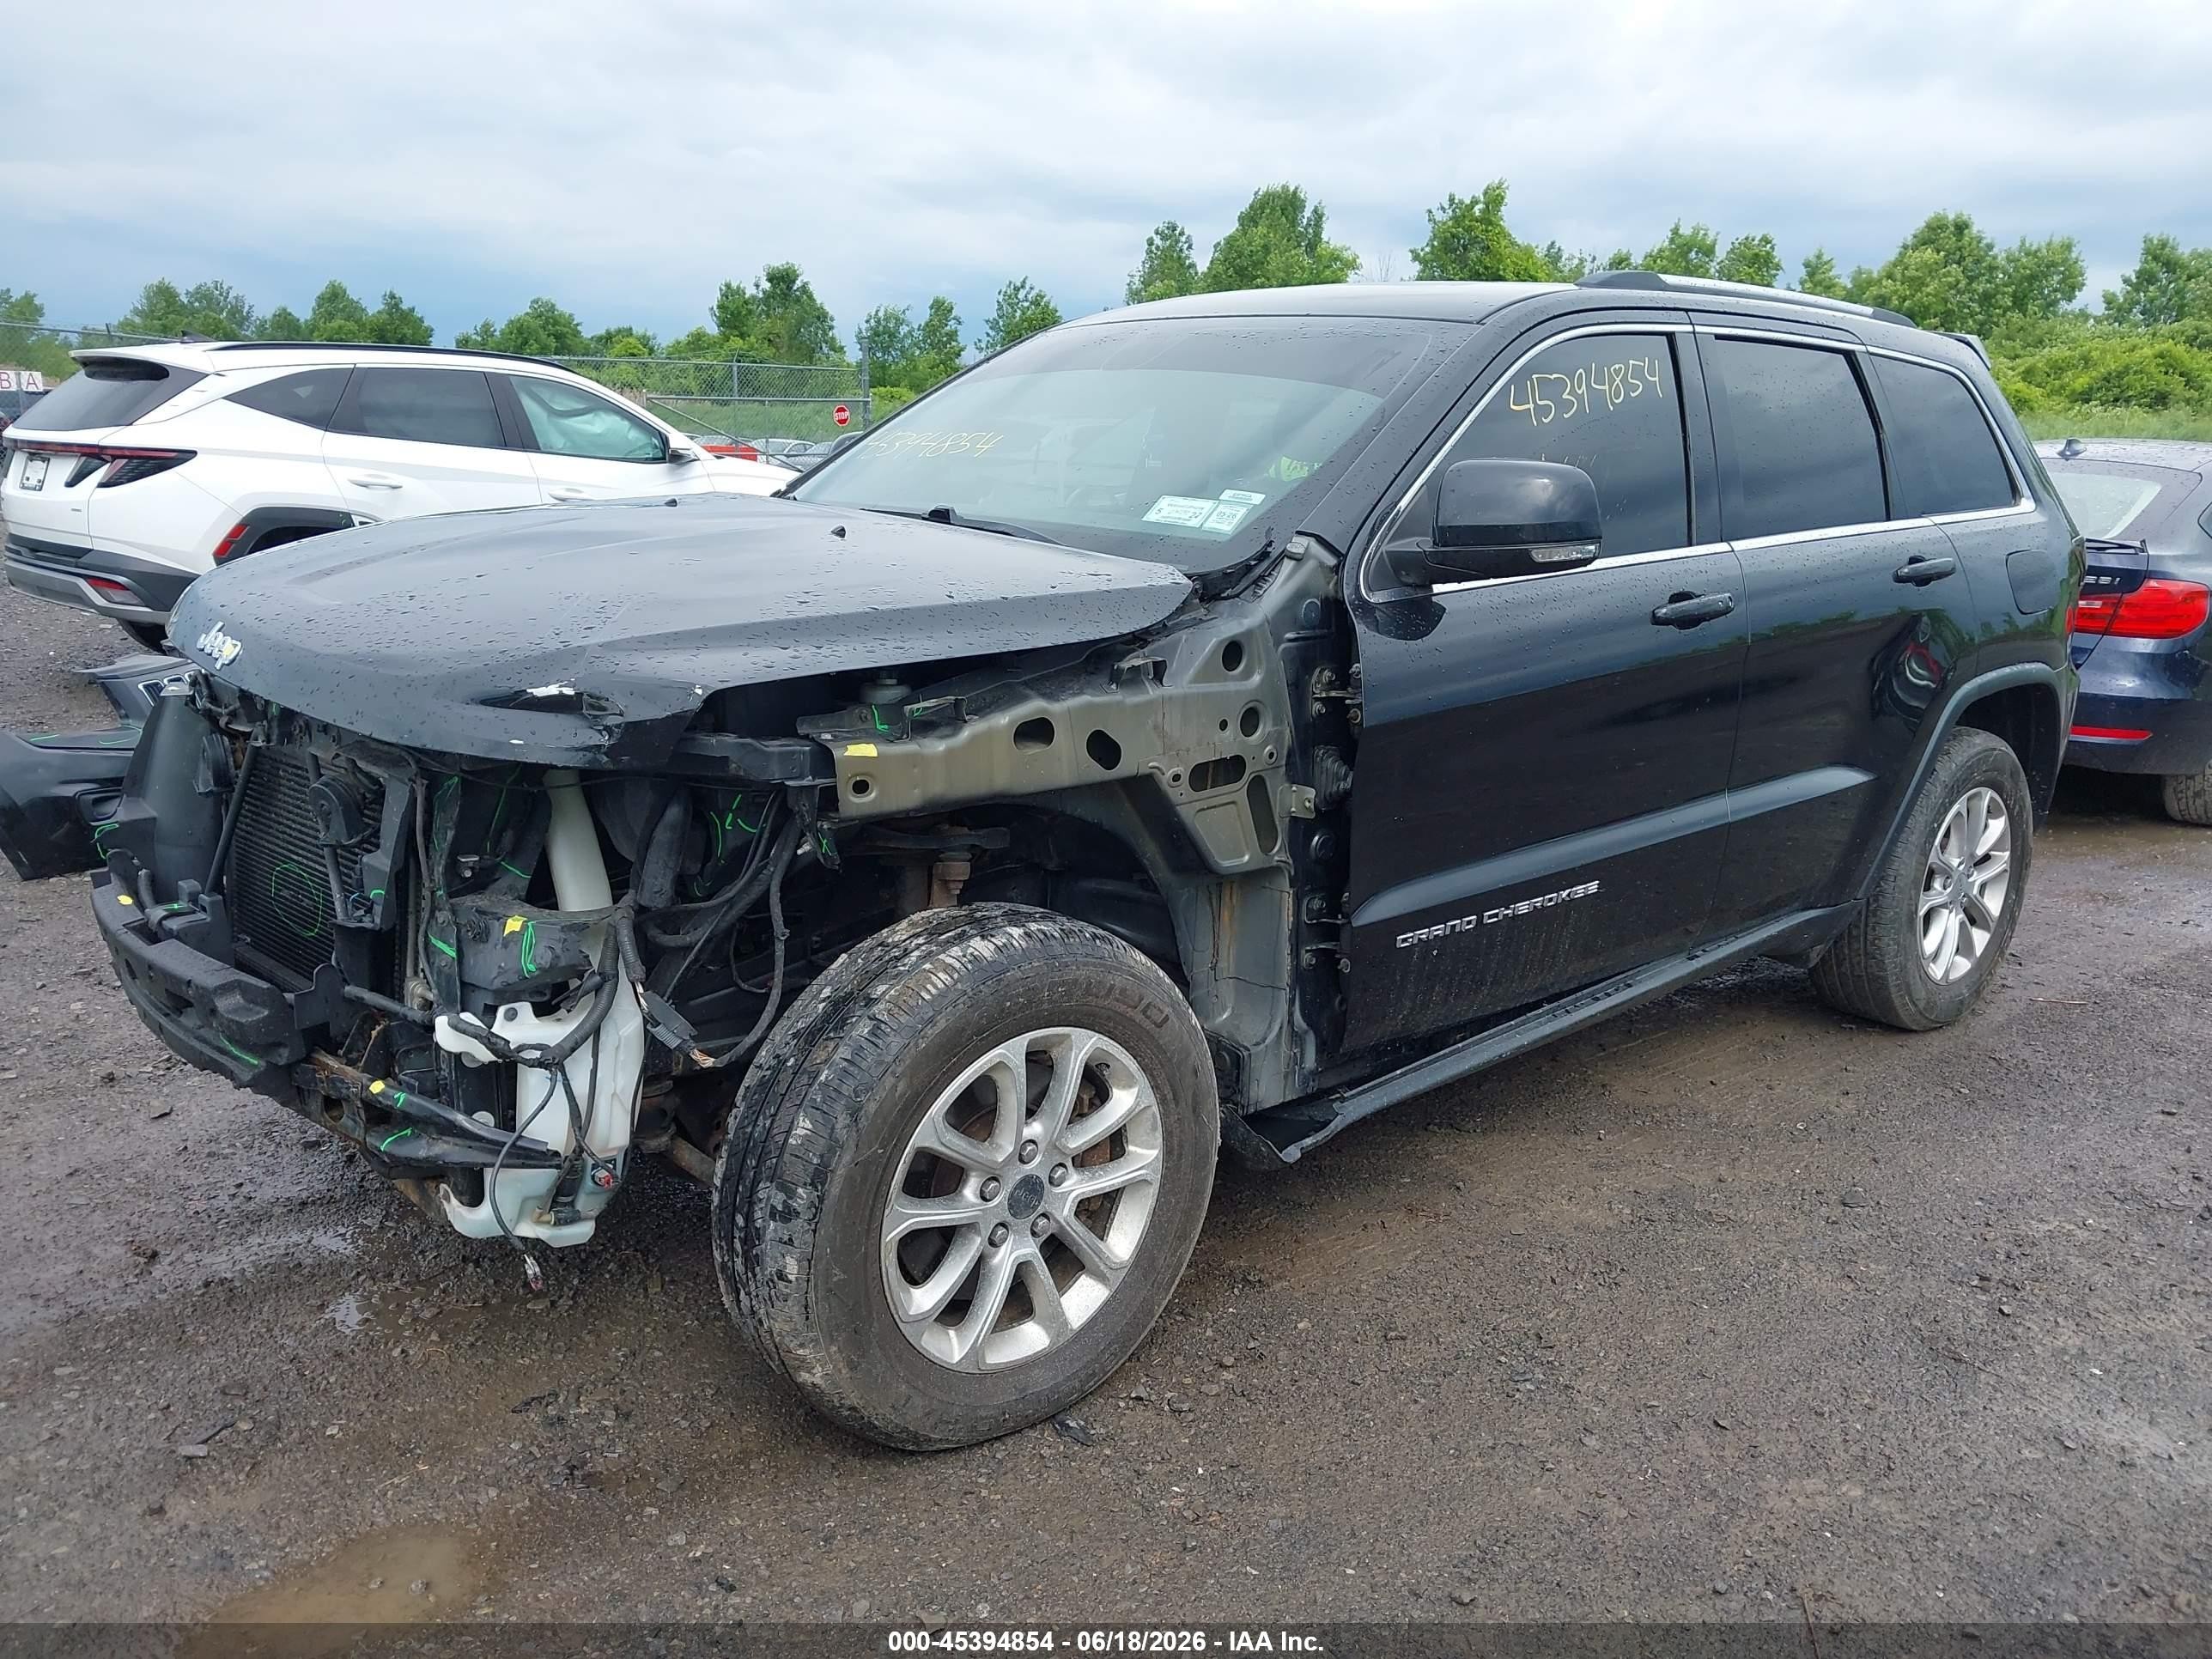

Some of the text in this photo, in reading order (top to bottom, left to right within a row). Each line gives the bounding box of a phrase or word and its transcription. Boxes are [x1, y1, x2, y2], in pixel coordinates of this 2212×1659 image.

[26, 372, 40, 390] A
[1509, 356, 1663, 427] 45394854
[835, 411, 849, 421] STOP
[196, 621, 242, 671] Jeep
[1395, 880, 1600, 949] GRAND CHEROKEE
